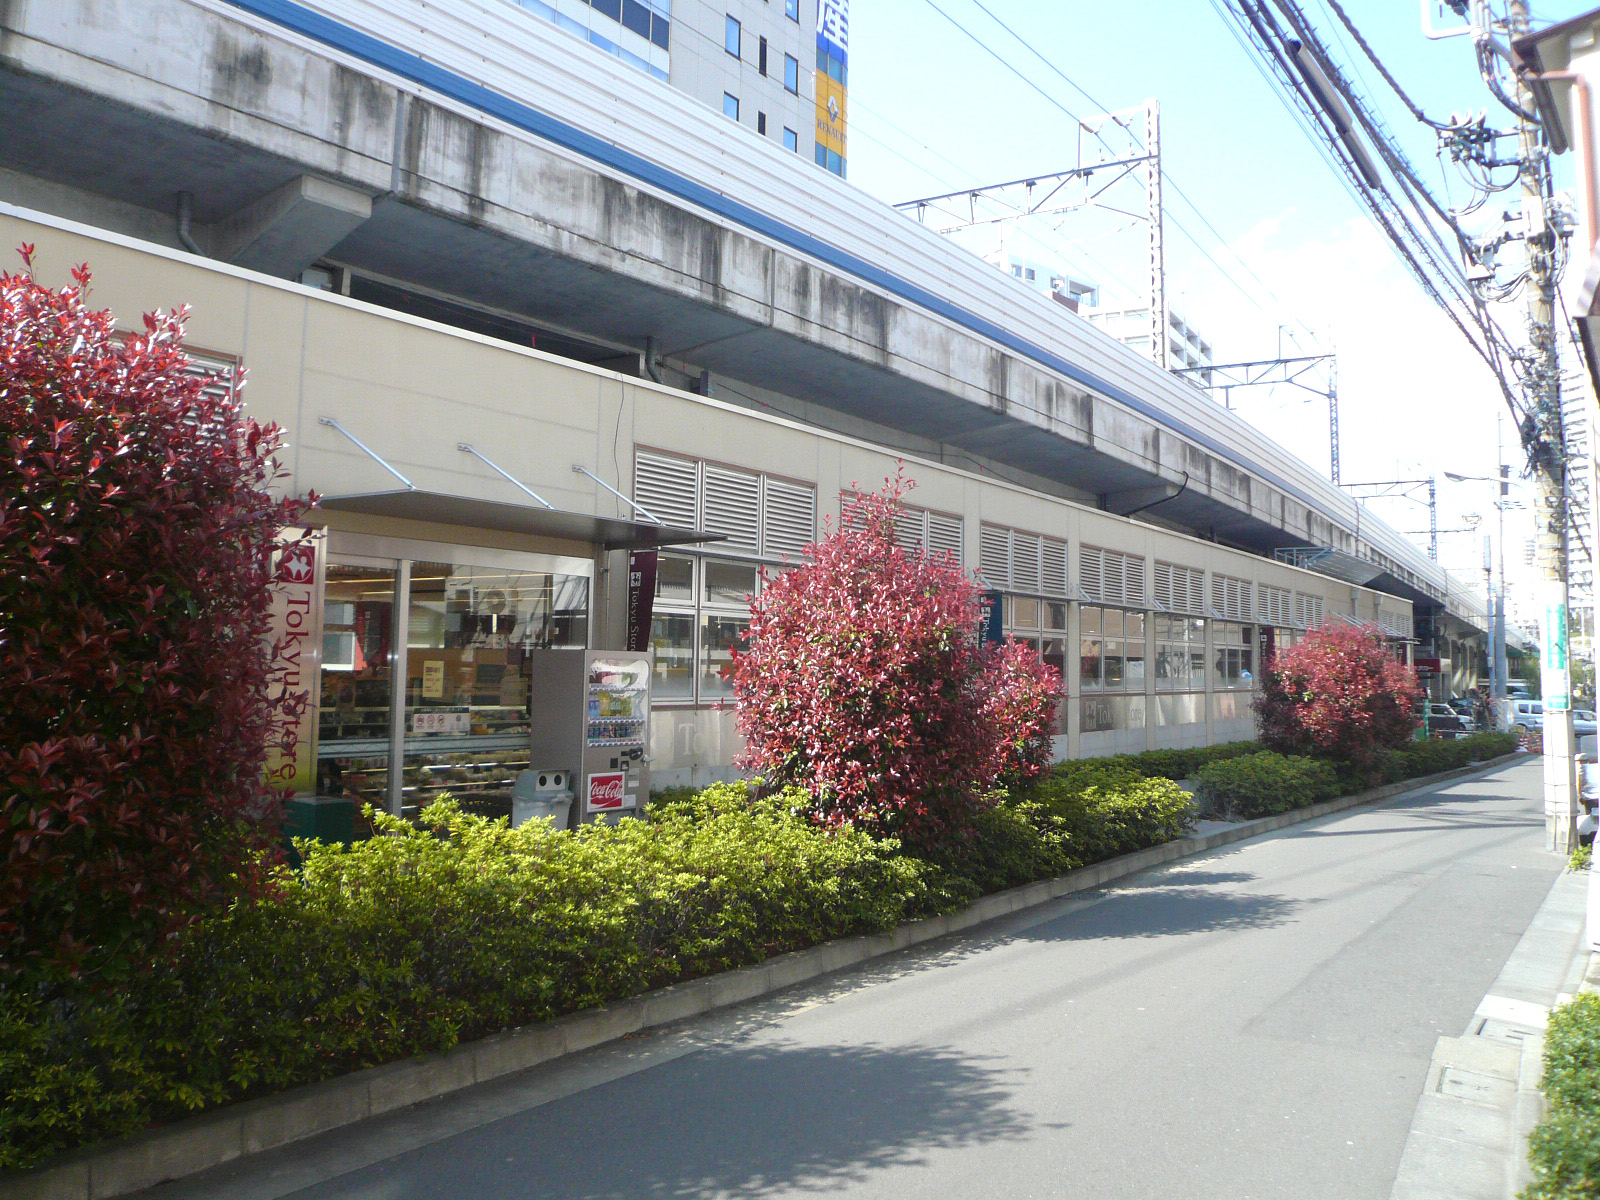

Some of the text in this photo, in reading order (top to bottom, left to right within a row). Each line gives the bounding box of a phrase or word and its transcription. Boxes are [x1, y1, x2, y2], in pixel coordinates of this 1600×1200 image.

[817, 119, 847, 144] RENAULT
[280, 590, 311, 686] Tokyu
[630, 587, 640, 651] Tokyu Stor
